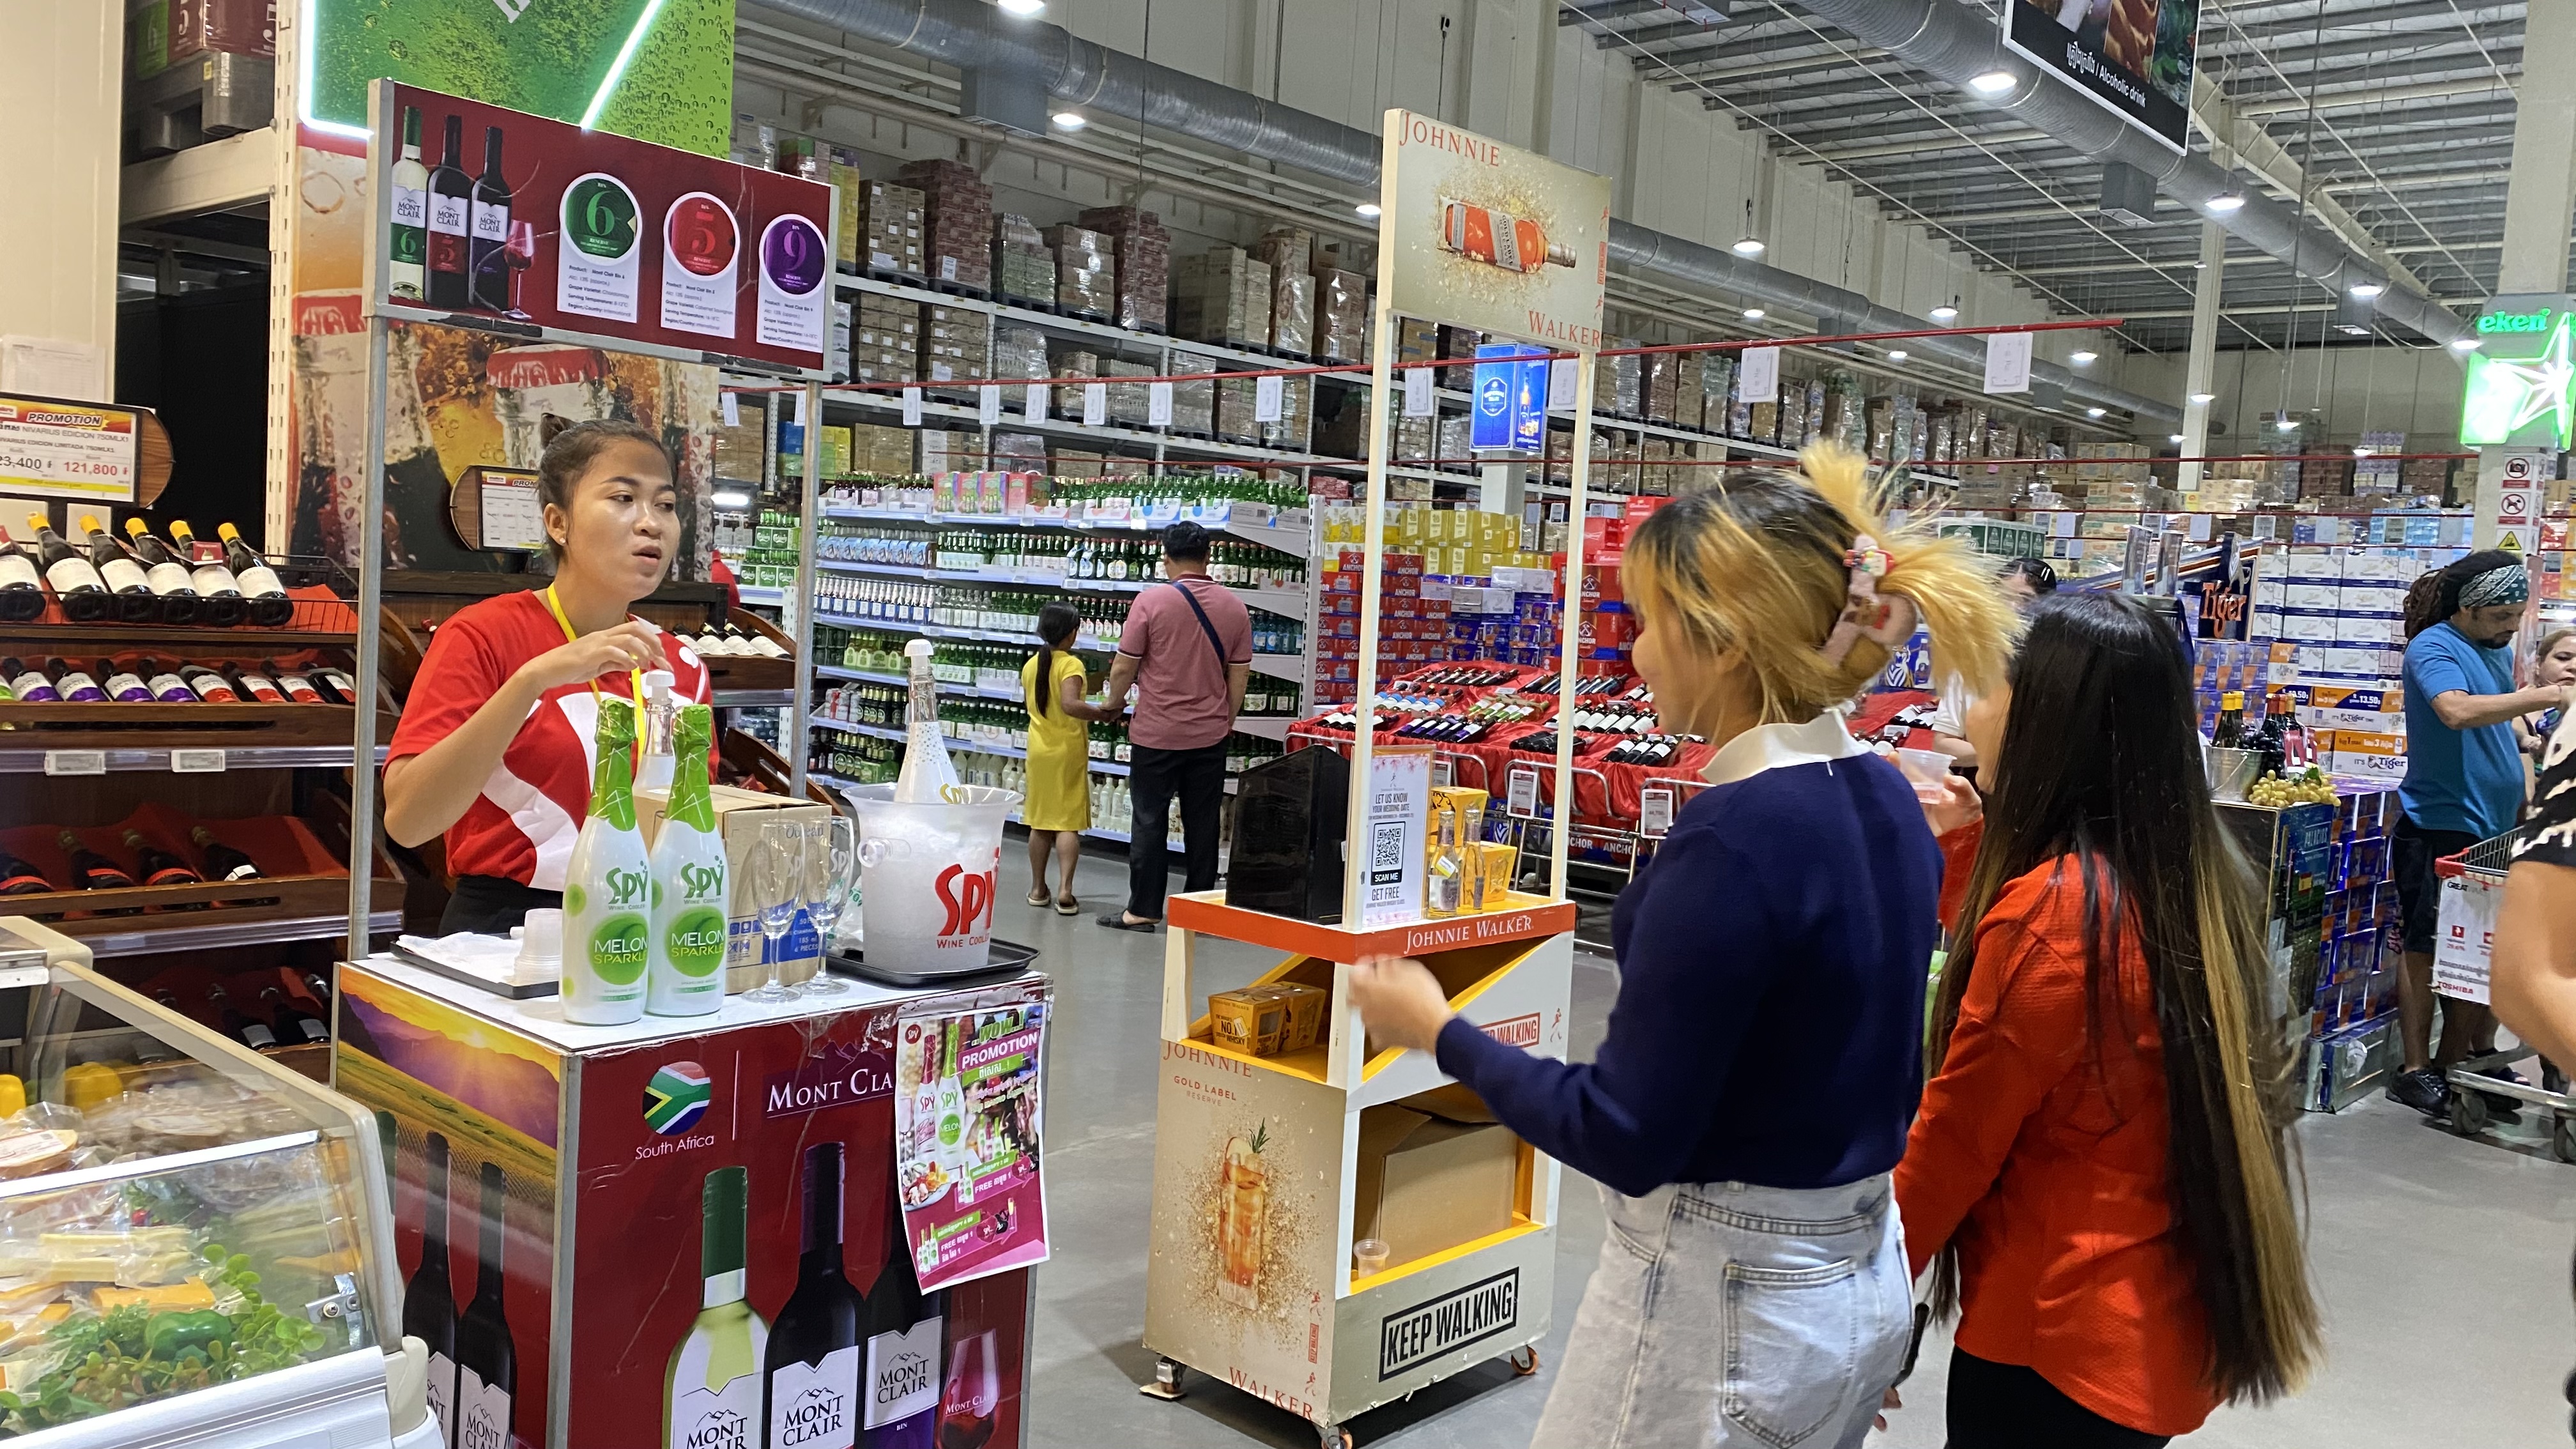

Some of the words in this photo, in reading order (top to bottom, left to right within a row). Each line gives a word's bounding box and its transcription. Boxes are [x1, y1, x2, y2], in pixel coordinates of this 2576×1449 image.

[2099, 65, 2129, 96] Alcoholic
[2129, 86, 2146, 108] drink
[1399, 112, 1500, 167] JOHNNIE
[397, 209, 421, 219] CLAIR
[398, 201, 421, 212] MONT
[438, 210, 461, 220] MONT
[586, 191, 615, 236] 6
[436, 217, 460, 227] CLAIR
[479, 224, 500, 233] CLAIR
[480, 217, 501, 227] MONT
[691, 211, 716, 255] 5
[401, 231, 415, 254] 6
[783, 231, 806, 271] 9
[1529, 310, 1601, 348] WALKER
[28, 413, 101, 425] PROMOTION
[22, 426, 60, 436] NIVARIUS
[61, 430, 95, 440] EDICION
[64, 461, 118, 476] 121,800
[1395, 588, 1415, 597] ANCHOR
[2200, 581, 2247, 639] Tiger
[2379, 757, 2406, 770] Tiger
[1376, 793, 1384, 804] LET
[1385, 793, 1392, 803] US
[1393, 792, 1408, 802] KNOW
[606, 867, 648, 905] SPY
[680, 862, 724, 898] SPY
[1374, 873, 1390, 882] SCAN
[1390, 872, 1399, 881] ME
[935, 863, 997, 937] SPY
[1372, 887, 1384, 901] GET
[1384, 885, 1400, 900] FREE
[671, 928, 725, 947] MELON
[1404, 926, 1469, 954] JOHNNIE
[1476, 914, 1532, 940] WALKER
[594, 936, 648, 954] MELON
[671, 942, 724, 958] SPARKLE
[801, 943, 818, 952] PIECES
[937, 939, 963, 949] WINE
[2437, 981, 2474, 995] TOSHIBA
[1226, 1034, 1245, 1046] WHISKY
[962, 1031, 1038, 1069] PROMOTION
[1163, 1041, 1253, 1078] JOHNNIE
[767, 1080, 844, 1112] MONT
[849, 1068, 894, 1094] CLA
[1174, 1074, 1201, 1090] GOLD
[1204, 1082, 1238, 1101] LABEL
[920, 1094, 935, 1112] SPY
[940, 1091, 958, 1108] SPY
[1186, 1090, 1223, 1107] RESERVE
[635, 1140, 673, 1160] South
[675, 1133, 715, 1154] Africa
[974, 1180, 993, 1194] FREE
[940, 1239, 956, 1252] FREE
[1387, 1312, 1433, 1368] KEEP
[1435, 1280, 1515, 1347] WALKING
[878, 1358, 930, 1388] MONT
[877, 1375, 928, 1404] CLAIR
[1229, 1366, 1313, 1421] WALKER
[783, 1394, 845, 1430] MONT
[946, 1400, 970, 1415] MONT
[466, 1411, 500, 1448] MONT
[686, 1416, 748, 1449] MONT
[783, 1413, 843, 1447] CLAIR
[896, 1422, 908, 1431] BIN
